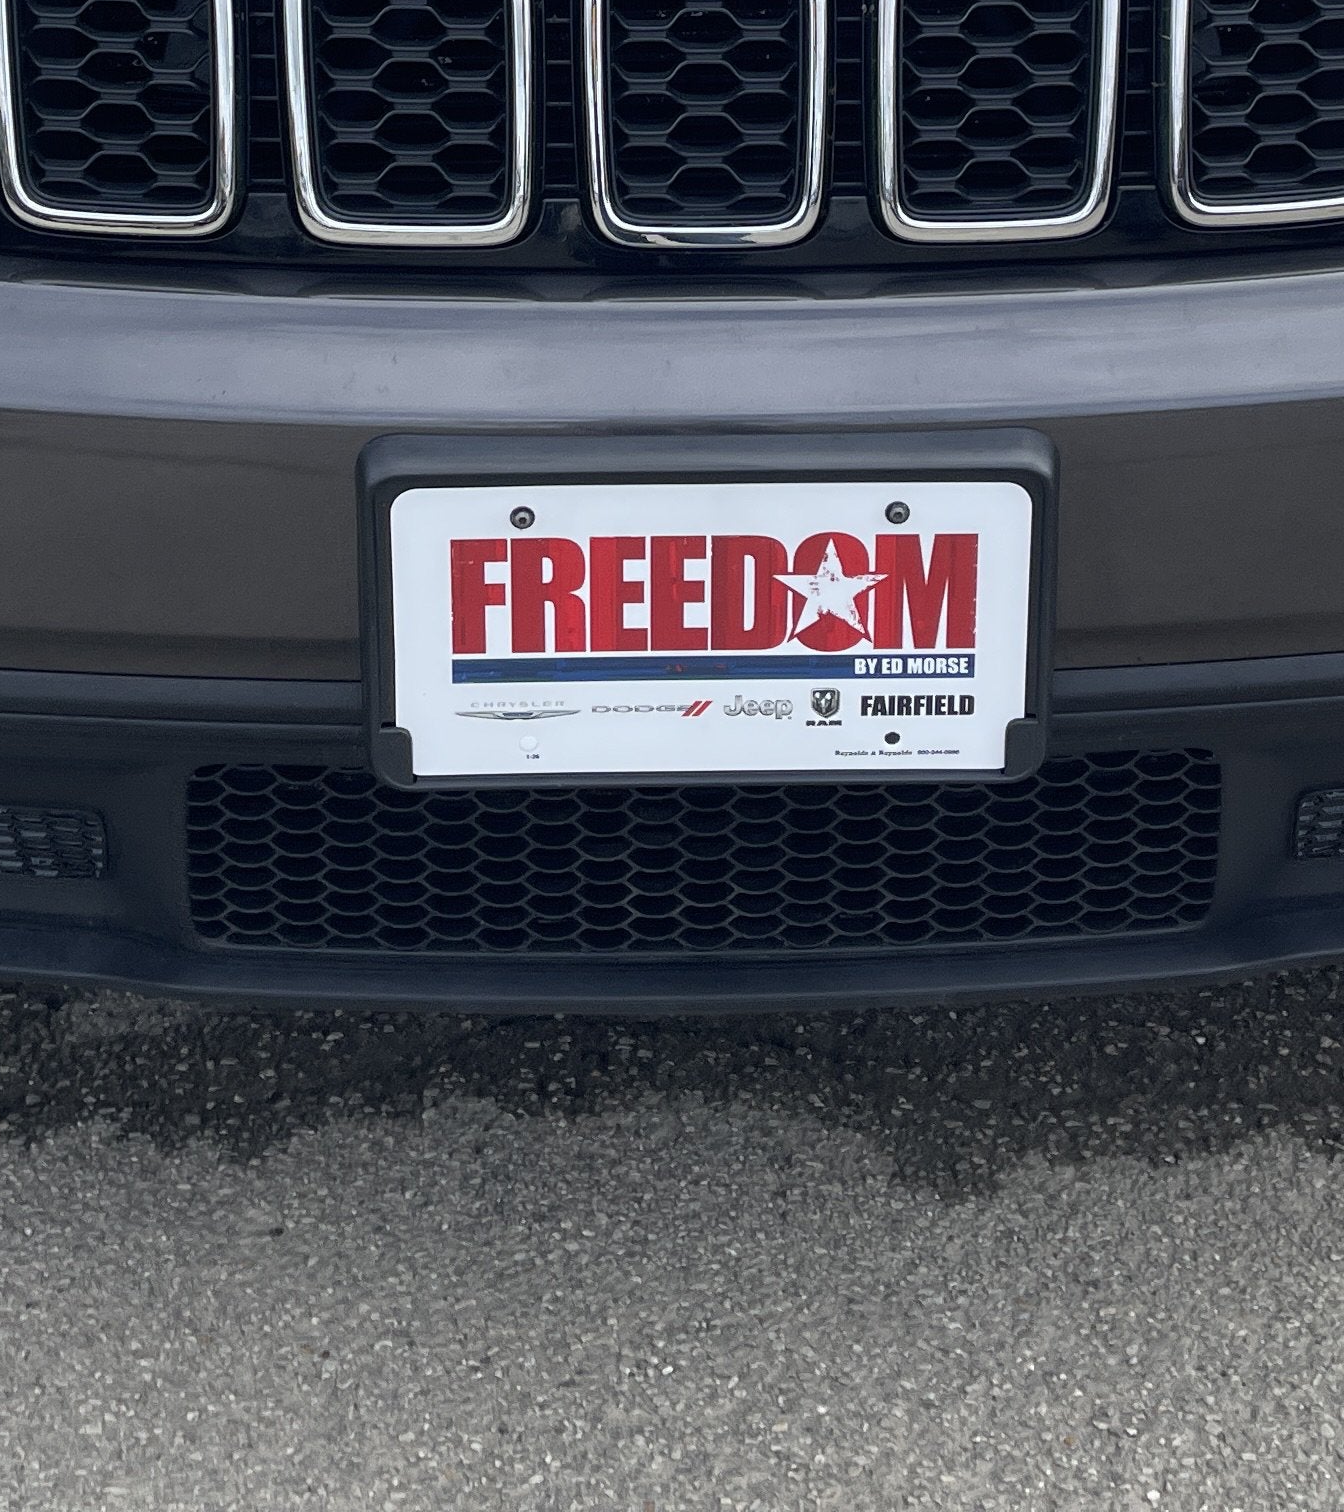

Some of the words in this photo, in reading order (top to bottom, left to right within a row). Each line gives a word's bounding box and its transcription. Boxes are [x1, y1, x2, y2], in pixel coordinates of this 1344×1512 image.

[450, 531, 979, 654] FREEDOM
[854, 658, 878, 675] BY
[881, 658, 904, 675] ED
[907, 657, 969, 674] MORSE
[470, 700, 565, 709] CHRYSLER
[591, 704, 694, 714] DODGE
[723, 694, 794, 720] Jeep
[860, 694, 975, 717] FAIRFIELD
[805, 719, 843, 727] RAM
